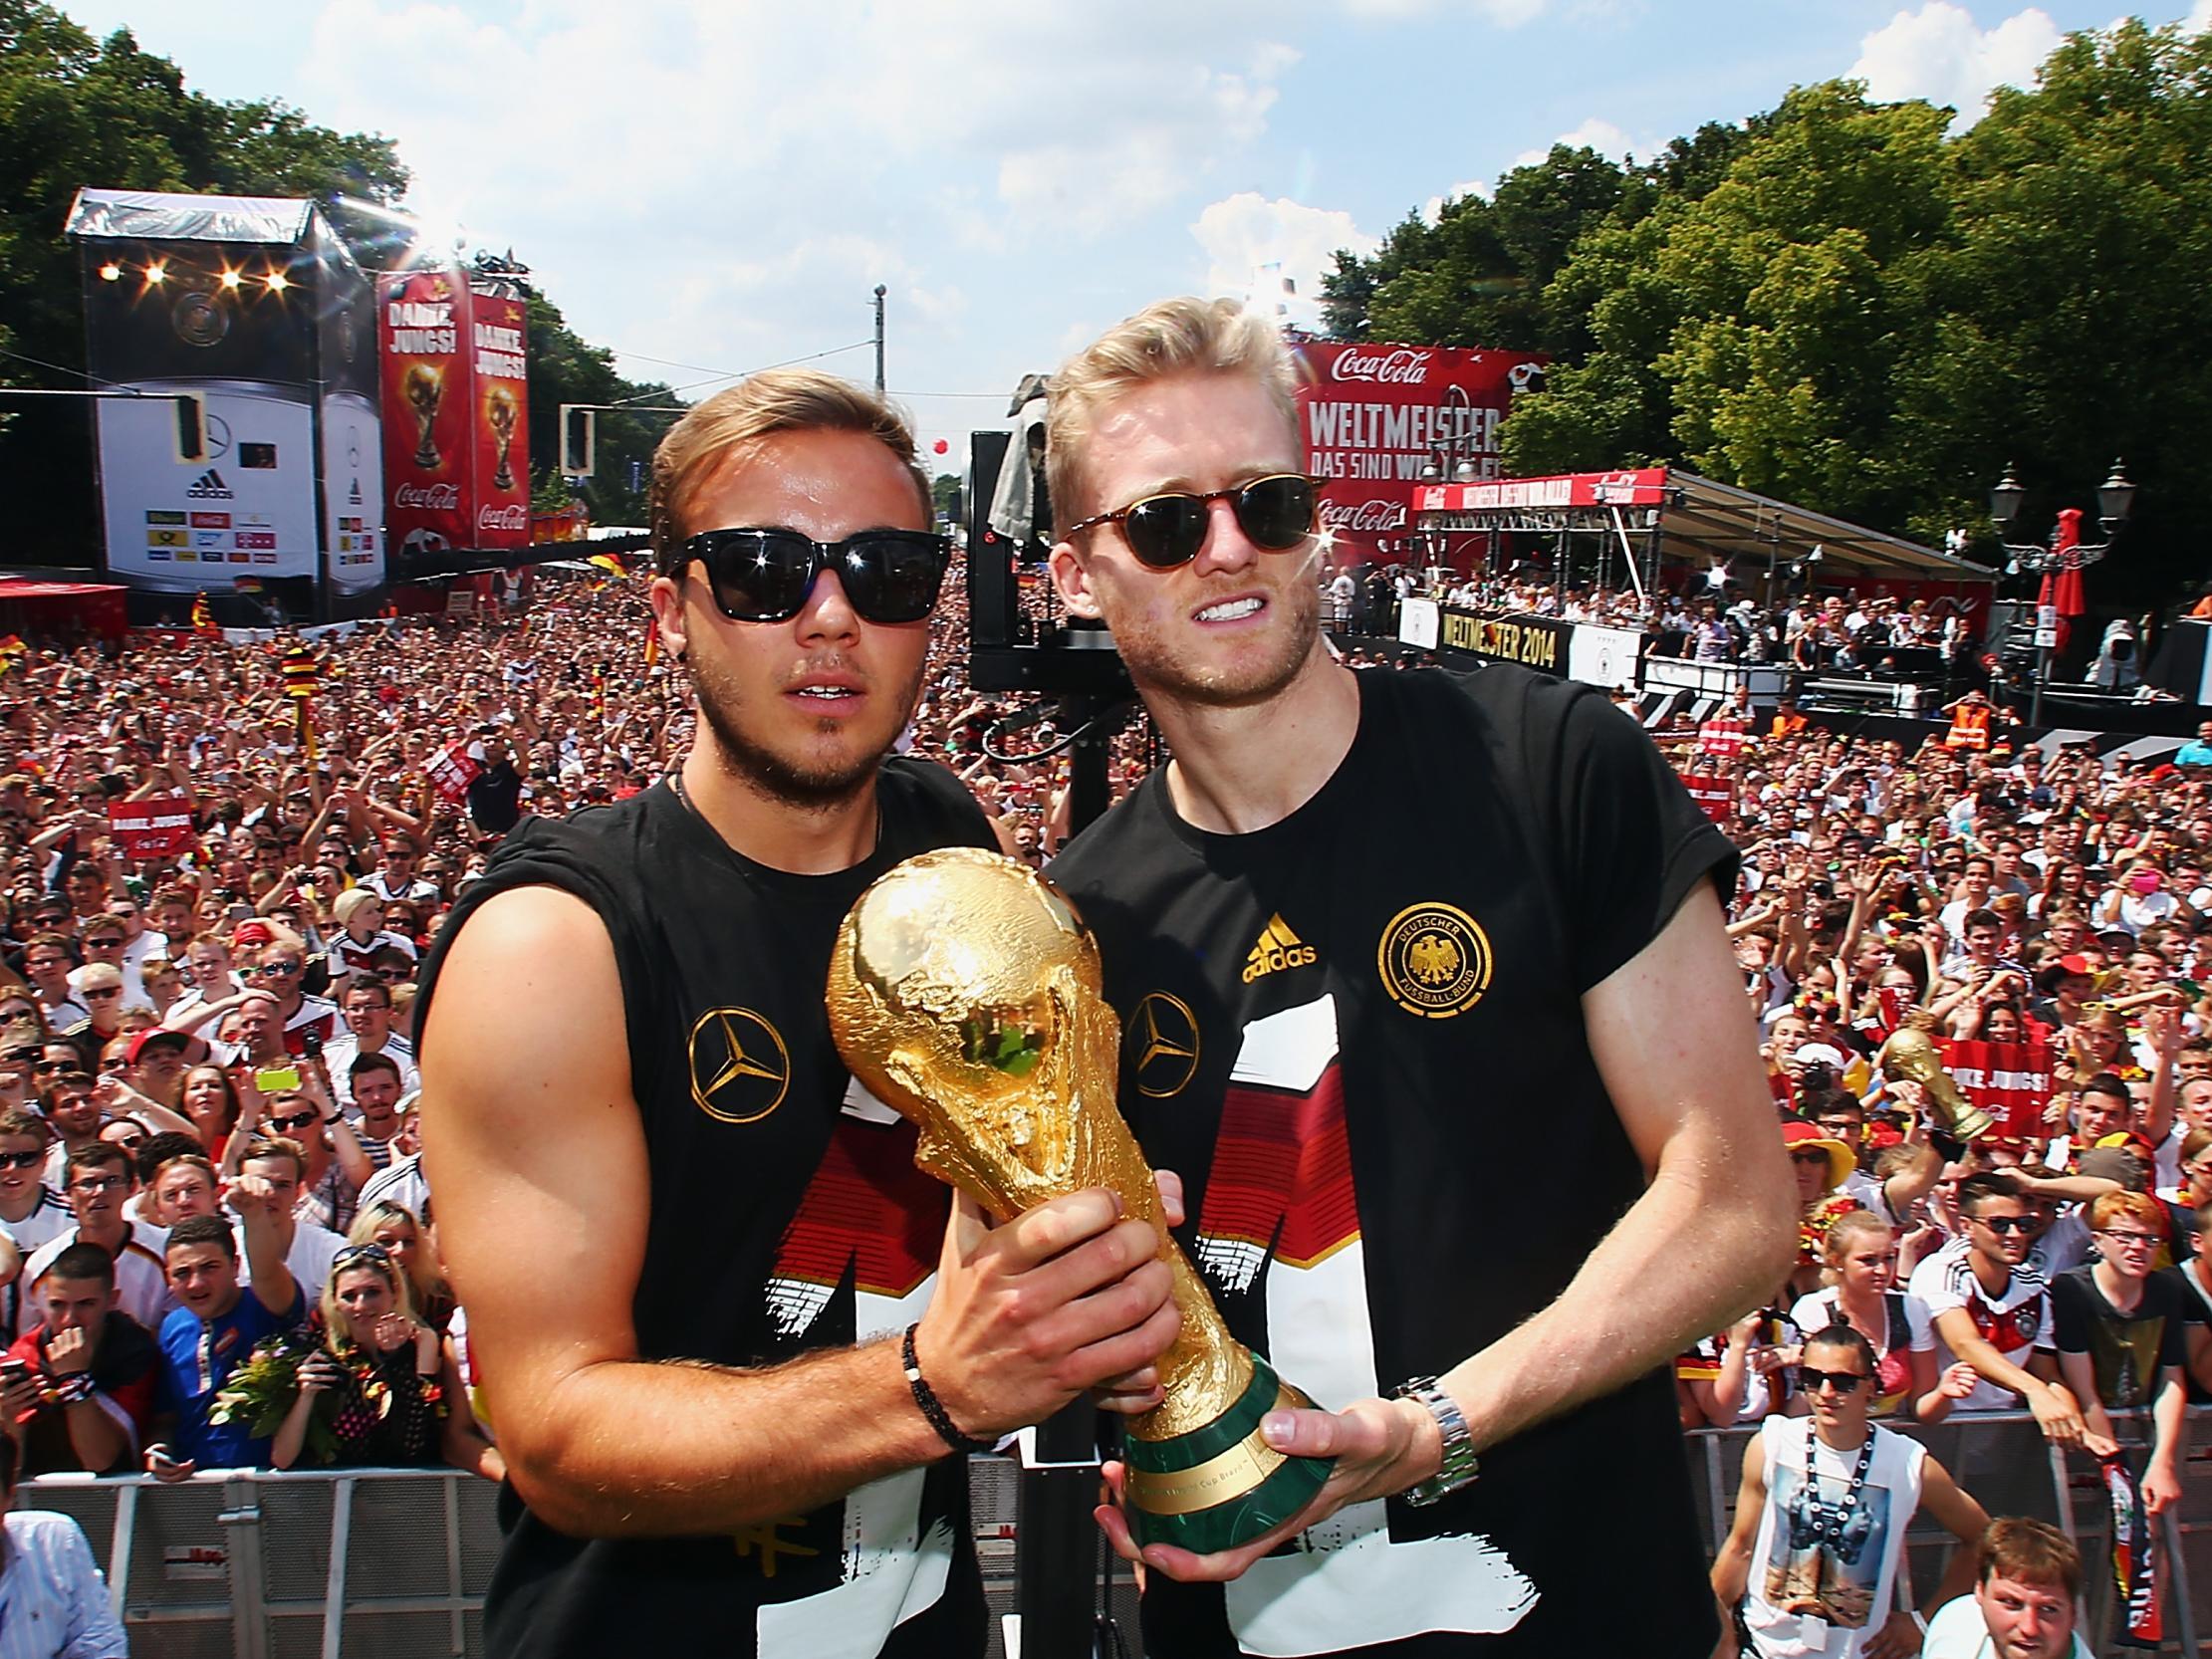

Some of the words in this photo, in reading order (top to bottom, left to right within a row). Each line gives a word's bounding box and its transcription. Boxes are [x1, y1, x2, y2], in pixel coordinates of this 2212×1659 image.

[389, 330, 457, 354] JUNGS!
[1332, 348, 1432, 384] Coca-Cola
[1309, 401, 1501, 453] WELTMEISTER
[1311, 452, 1346, 479] DAS
[1350, 452, 1392, 480] SIND
[395, 482, 460, 509] Coca-Cola
[478, 504, 527, 530] Coca-Cola
[1521, 626, 1556, 668] 2014
[1398, 917, 1461, 942] DEUTSCHER
[1242, 946, 1317, 984] adidas
